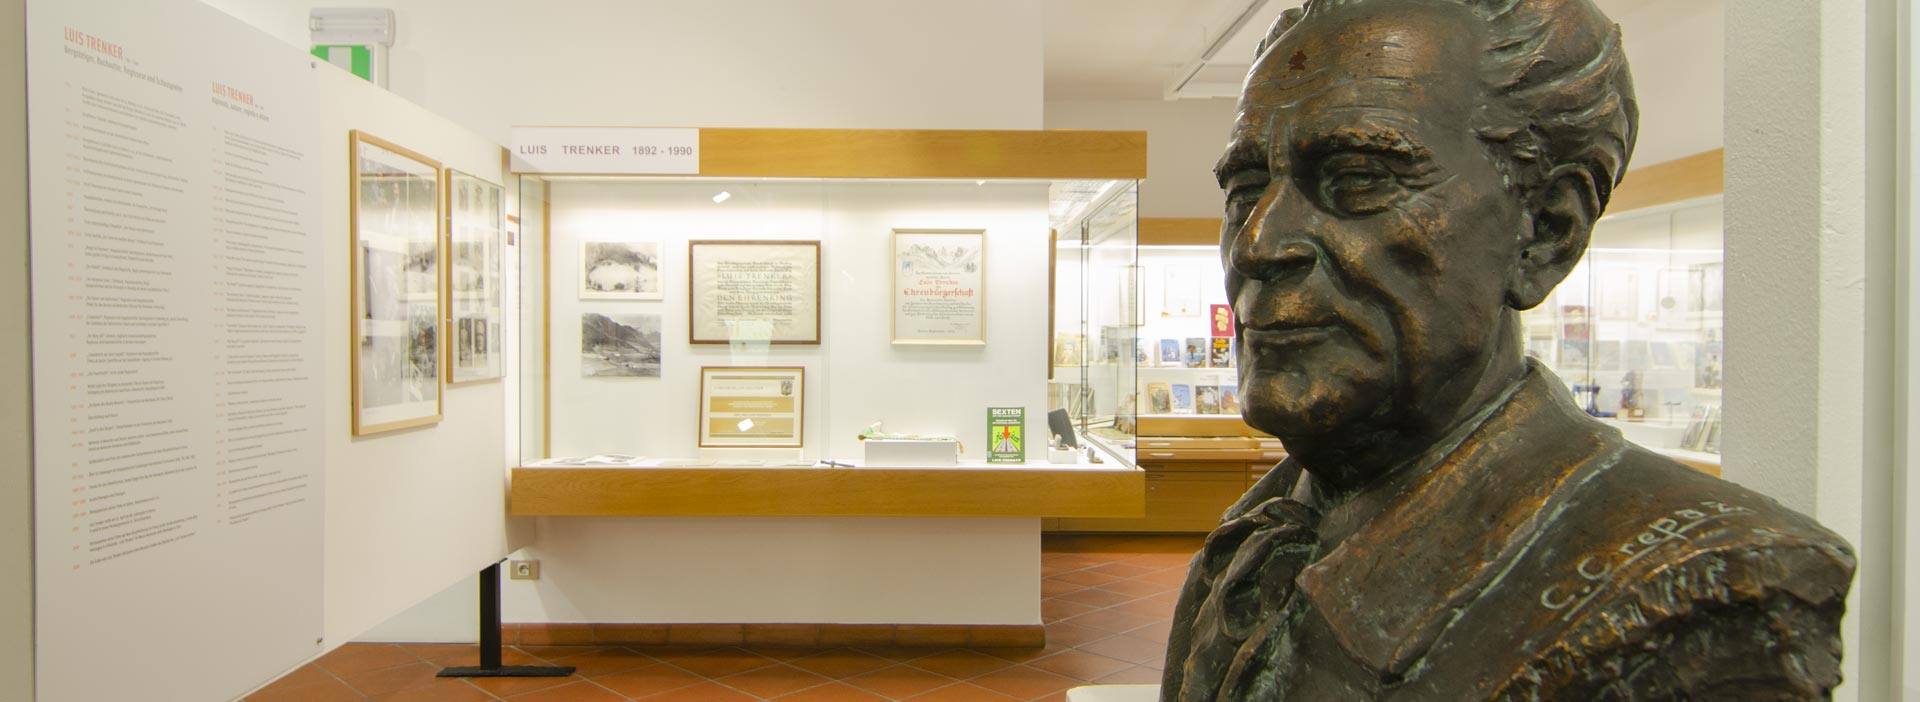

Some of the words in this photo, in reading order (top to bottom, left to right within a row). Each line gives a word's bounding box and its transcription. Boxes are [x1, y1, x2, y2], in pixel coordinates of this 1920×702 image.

[64, 26, 84, 45] LUIS
[86, 34, 123, 60] TRENKER
[211, 80, 226, 97] LUIS
[227, 86, 254, 106] TRENKER
[519, 145, 547, 154] LUIS
[562, 145, 620, 155] TRENKER
[632, 146, 657, 155] 1892
[668, 146, 693, 156] 1990
